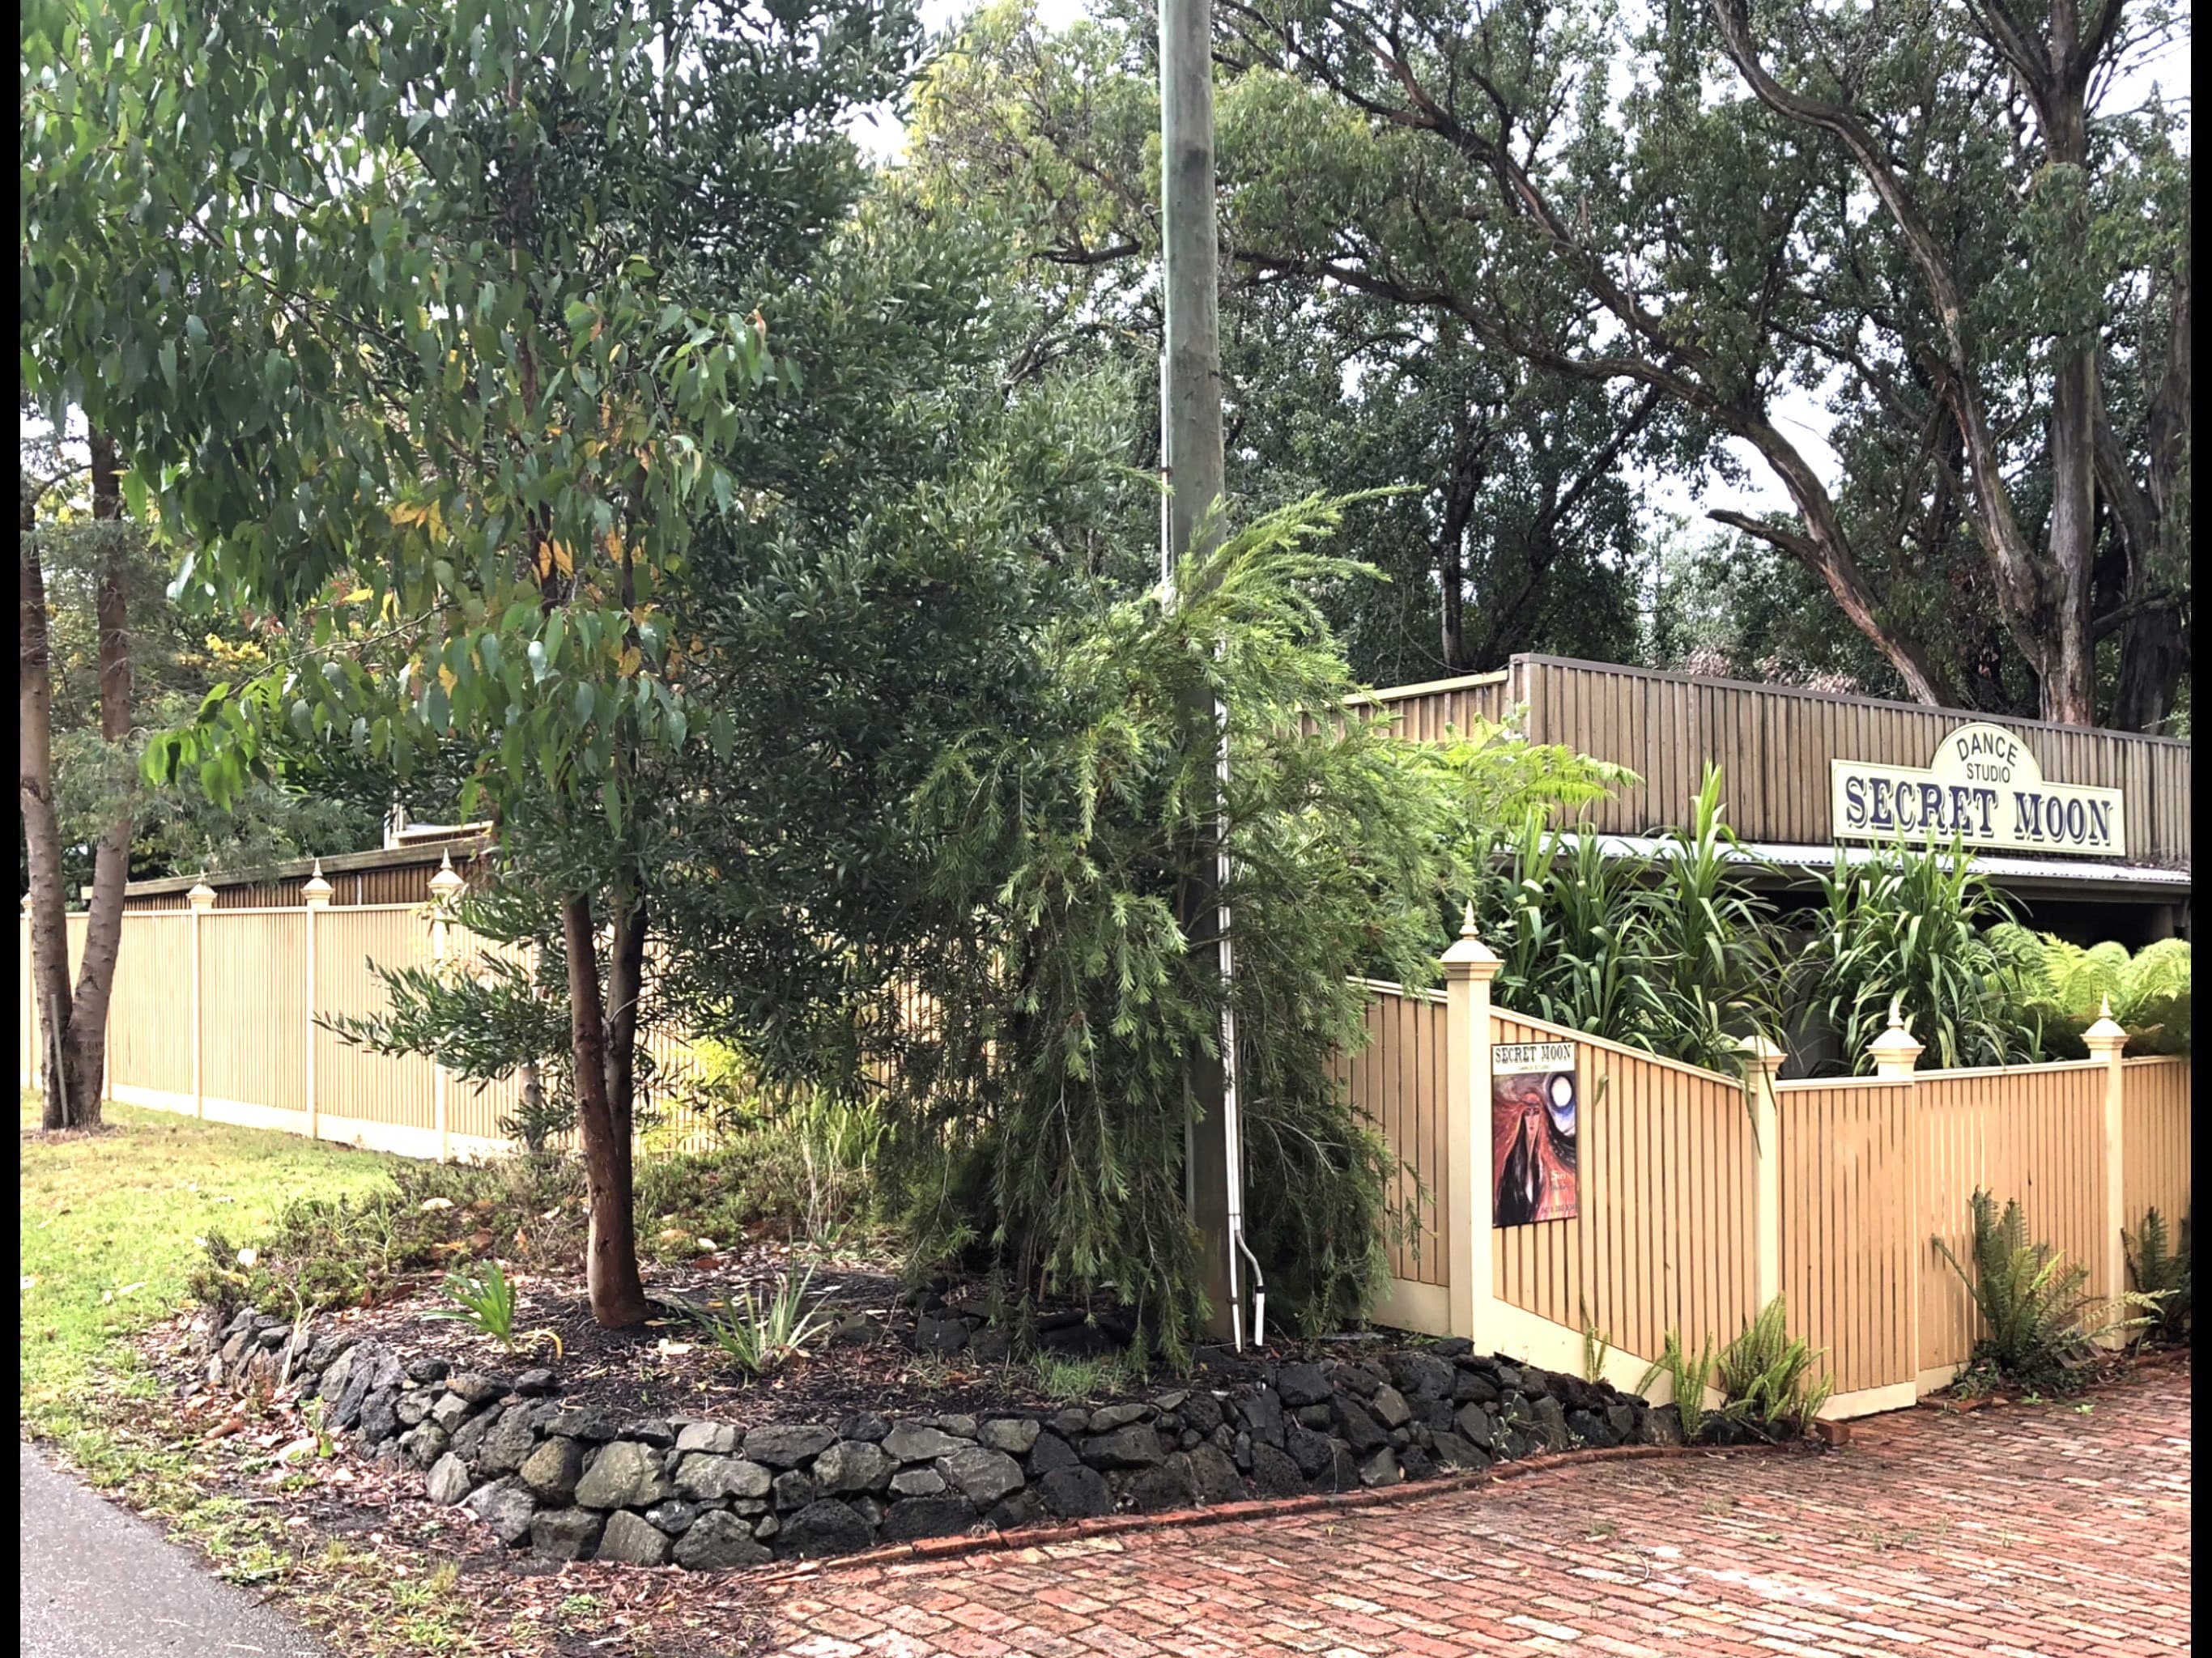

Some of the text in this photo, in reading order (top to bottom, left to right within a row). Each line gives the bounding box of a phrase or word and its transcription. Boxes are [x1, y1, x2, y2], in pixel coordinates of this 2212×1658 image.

[1956, 732, 2018, 768] DANCE
[1966, 762, 2011, 784] STUDIO
[1845, 776, 2112, 846] SECRET MOON
[1495, 1044, 1572, 1064] SECRET MOON
